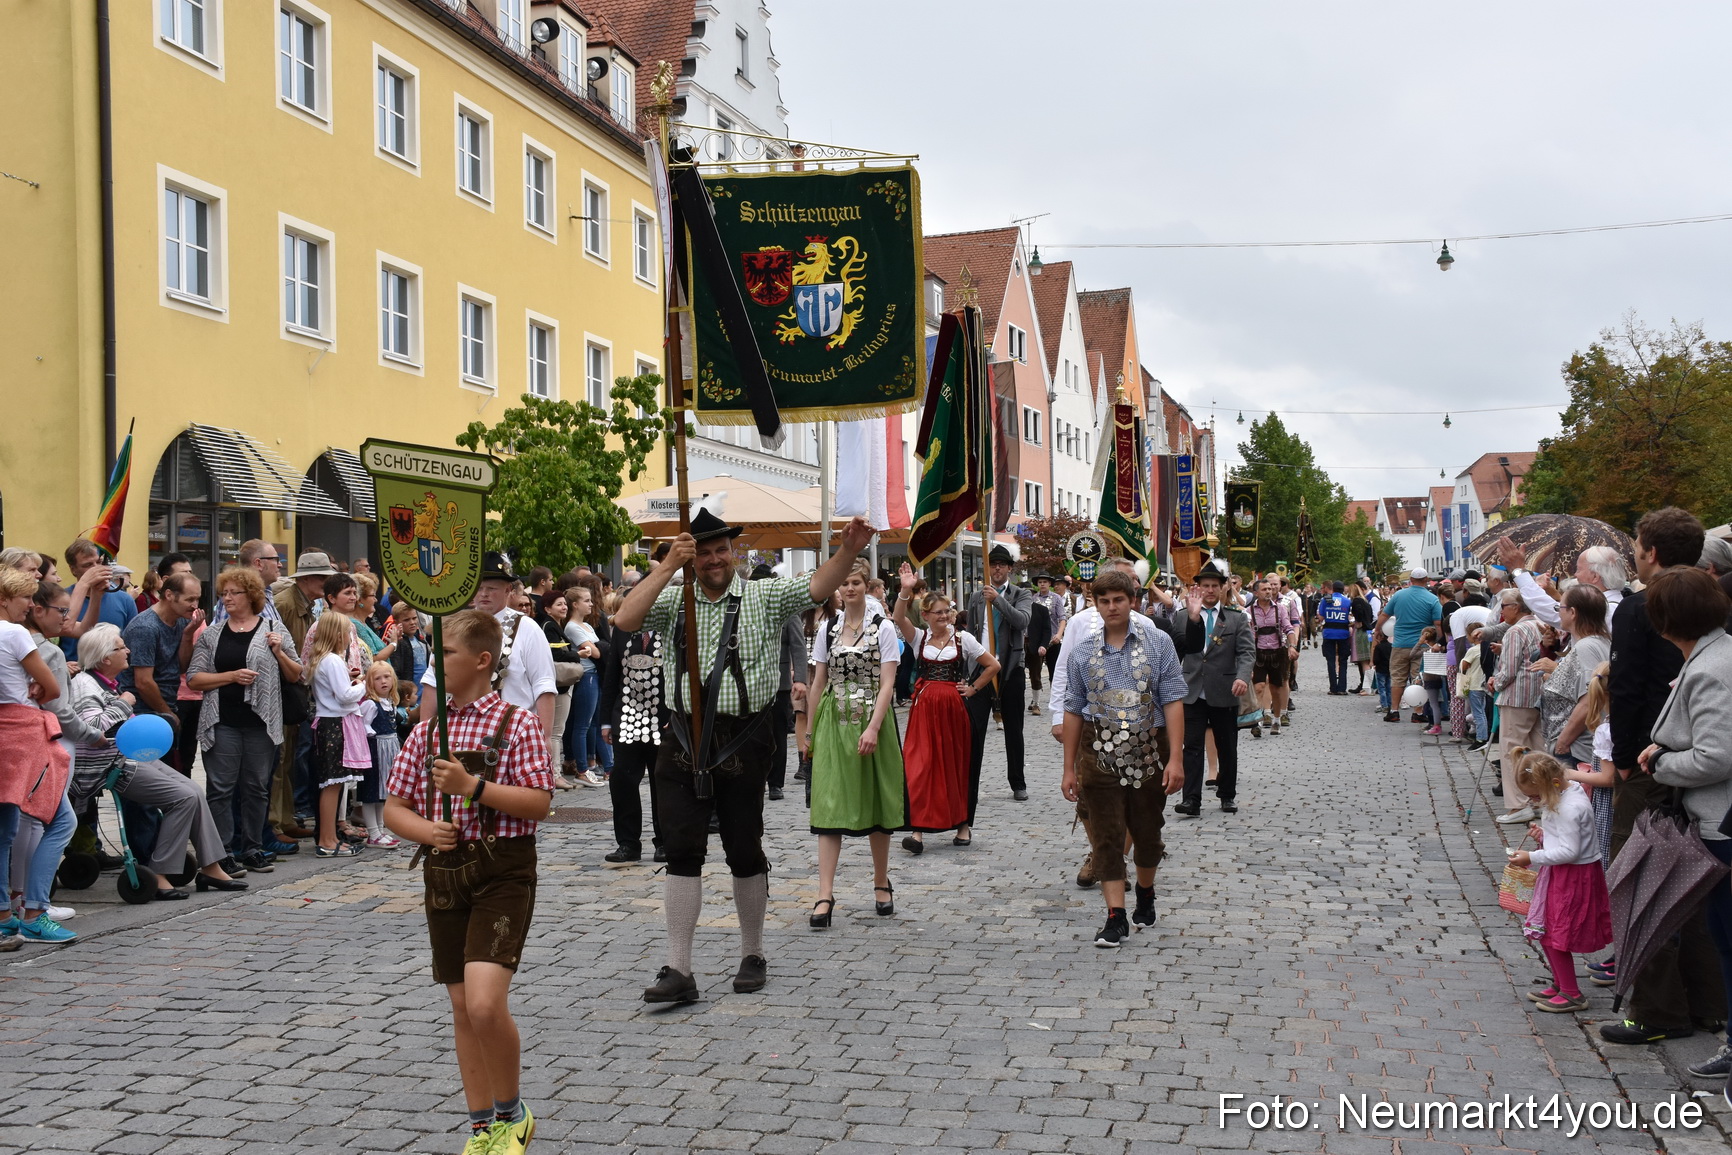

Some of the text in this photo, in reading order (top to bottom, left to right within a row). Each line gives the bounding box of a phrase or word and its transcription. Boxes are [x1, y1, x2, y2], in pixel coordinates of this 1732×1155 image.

[740, 200, 862, 228] Schützengau
[373, 452, 482, 481] SCHÜTZENGAU
[379, 516, 480, 609] ALTDORF-NEUMARKT-BEILNGRIES
[1326, 611, 1346, 621] LIVE
